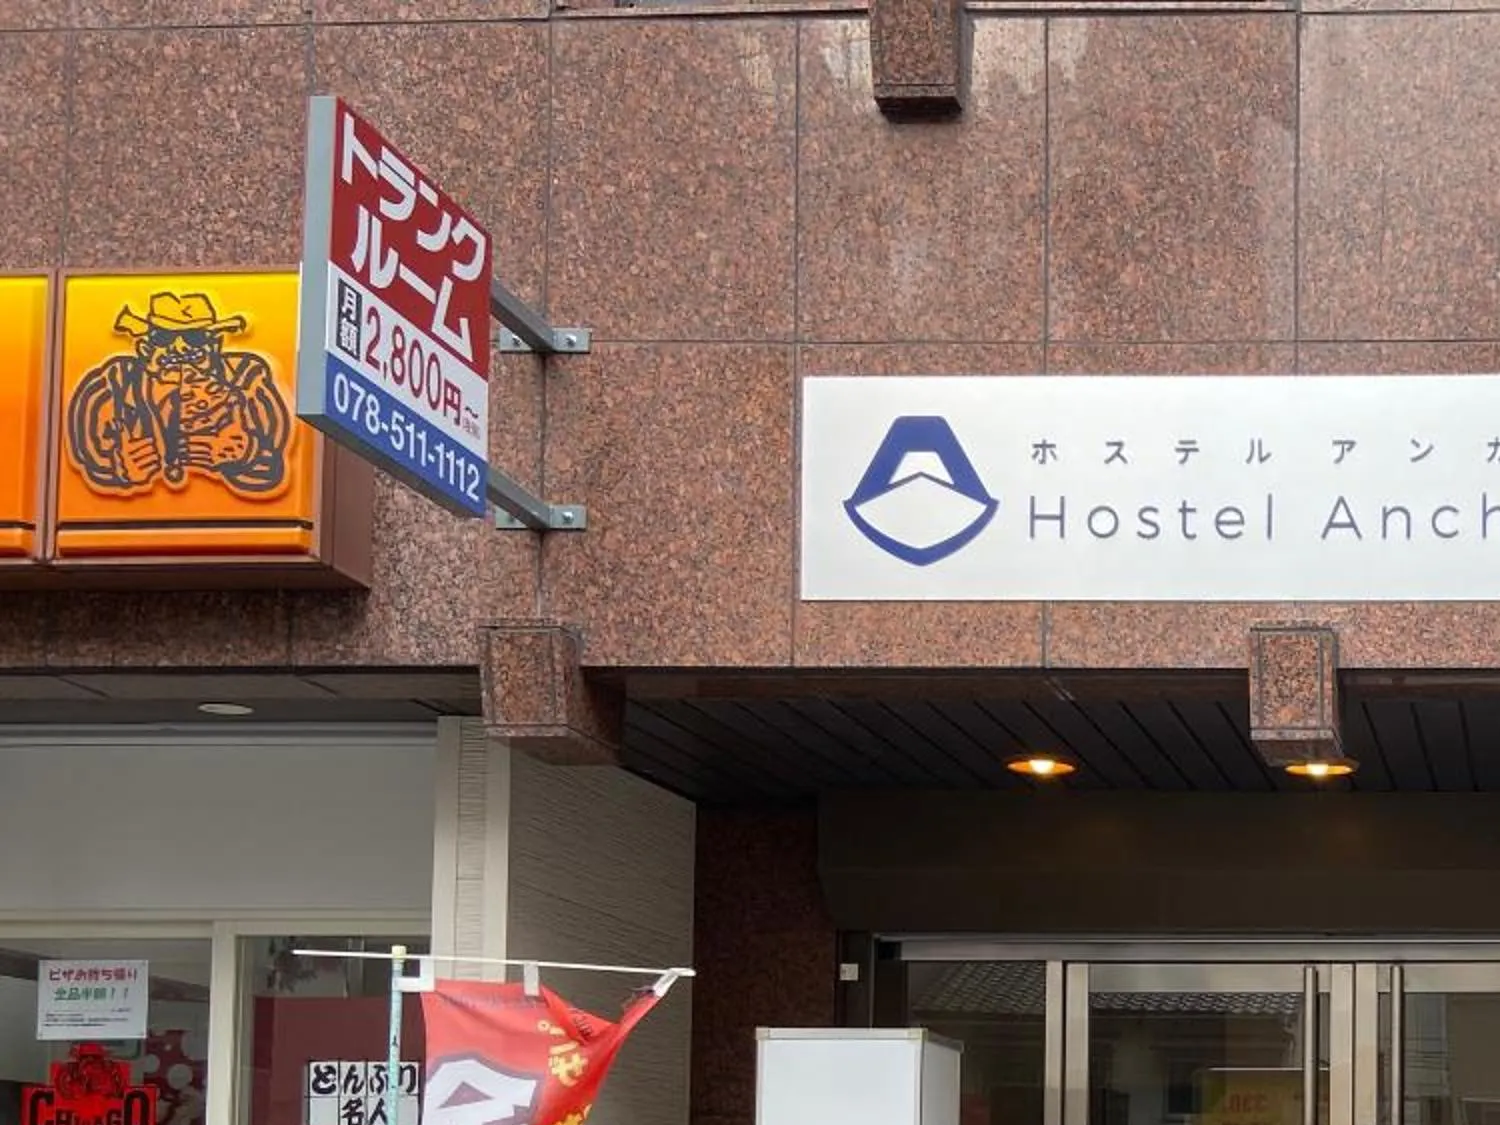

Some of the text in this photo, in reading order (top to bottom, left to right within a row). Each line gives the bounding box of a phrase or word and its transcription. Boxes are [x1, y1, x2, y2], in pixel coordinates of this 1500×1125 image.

[342, 112, 486, 281] トランク
[352, 205, 474, 361] ルーム
[334, 373, 480, 501] 078-511-1112
[1028, 494, 1274, 539] Hostel
